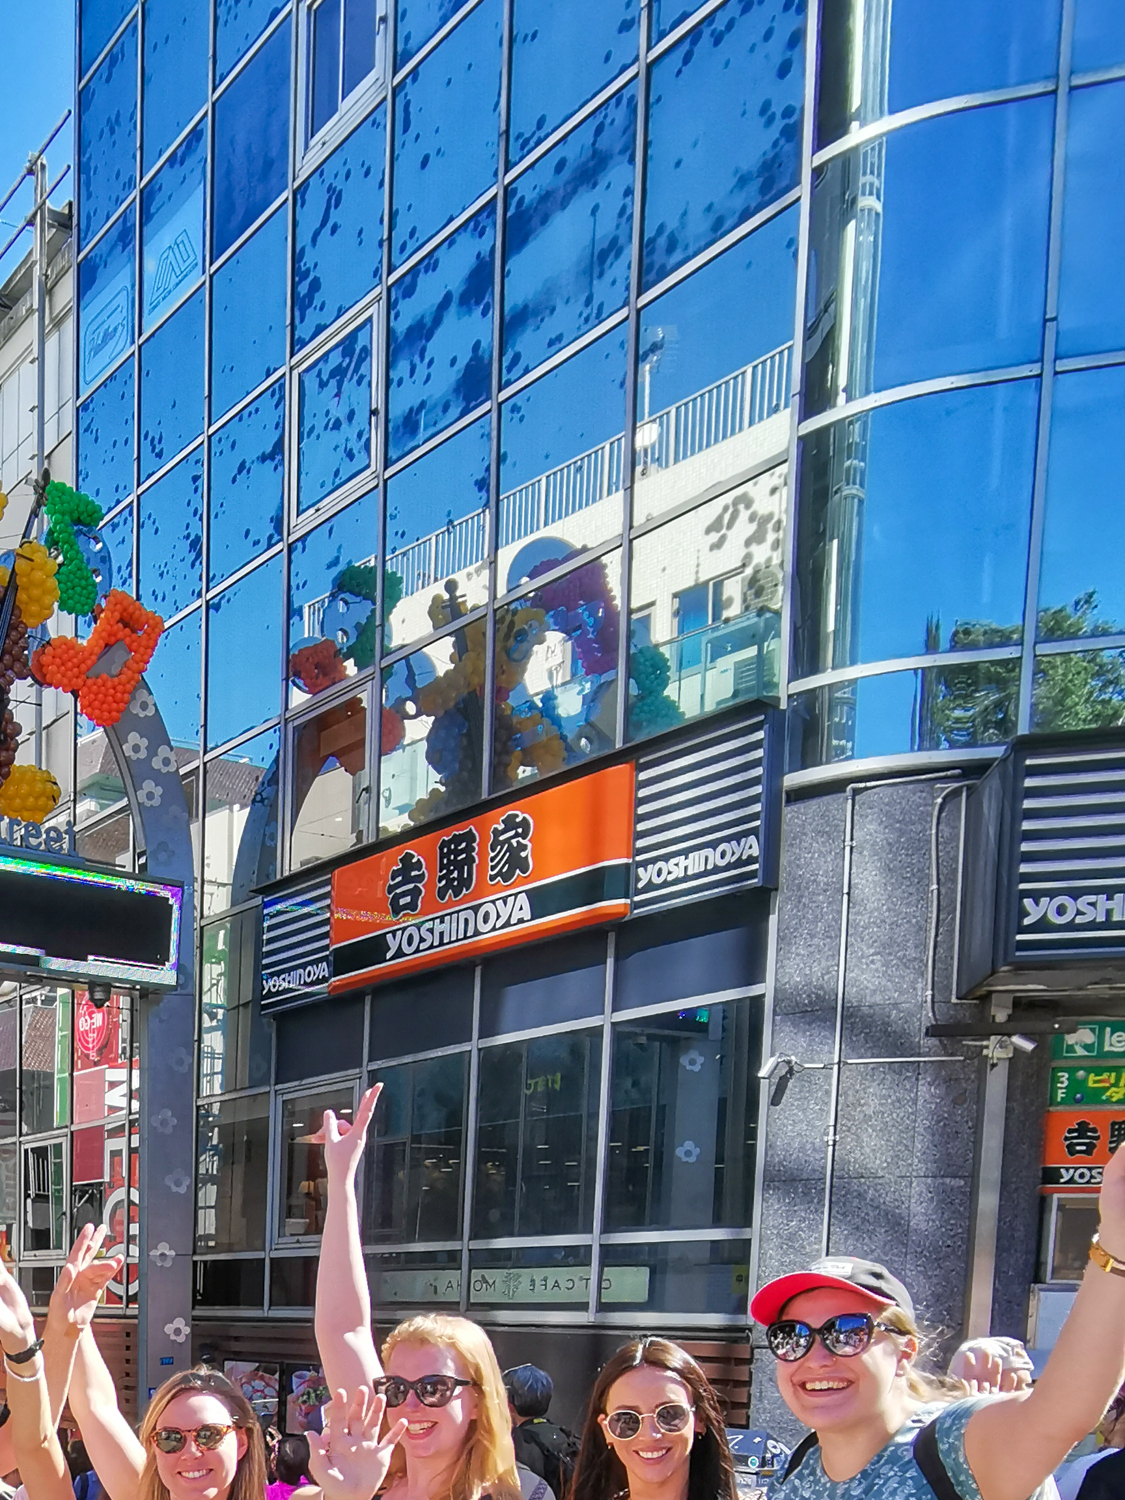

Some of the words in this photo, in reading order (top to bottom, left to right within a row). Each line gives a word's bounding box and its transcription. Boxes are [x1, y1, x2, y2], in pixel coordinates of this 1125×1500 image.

[387, 811, 534, 918] 吉野家
[637, 836, 759, 890] YOSHINOYA
[386, 893, 531, 959] YOSHINOYA
[262, 961, 329, 994] YOSHINOYA
